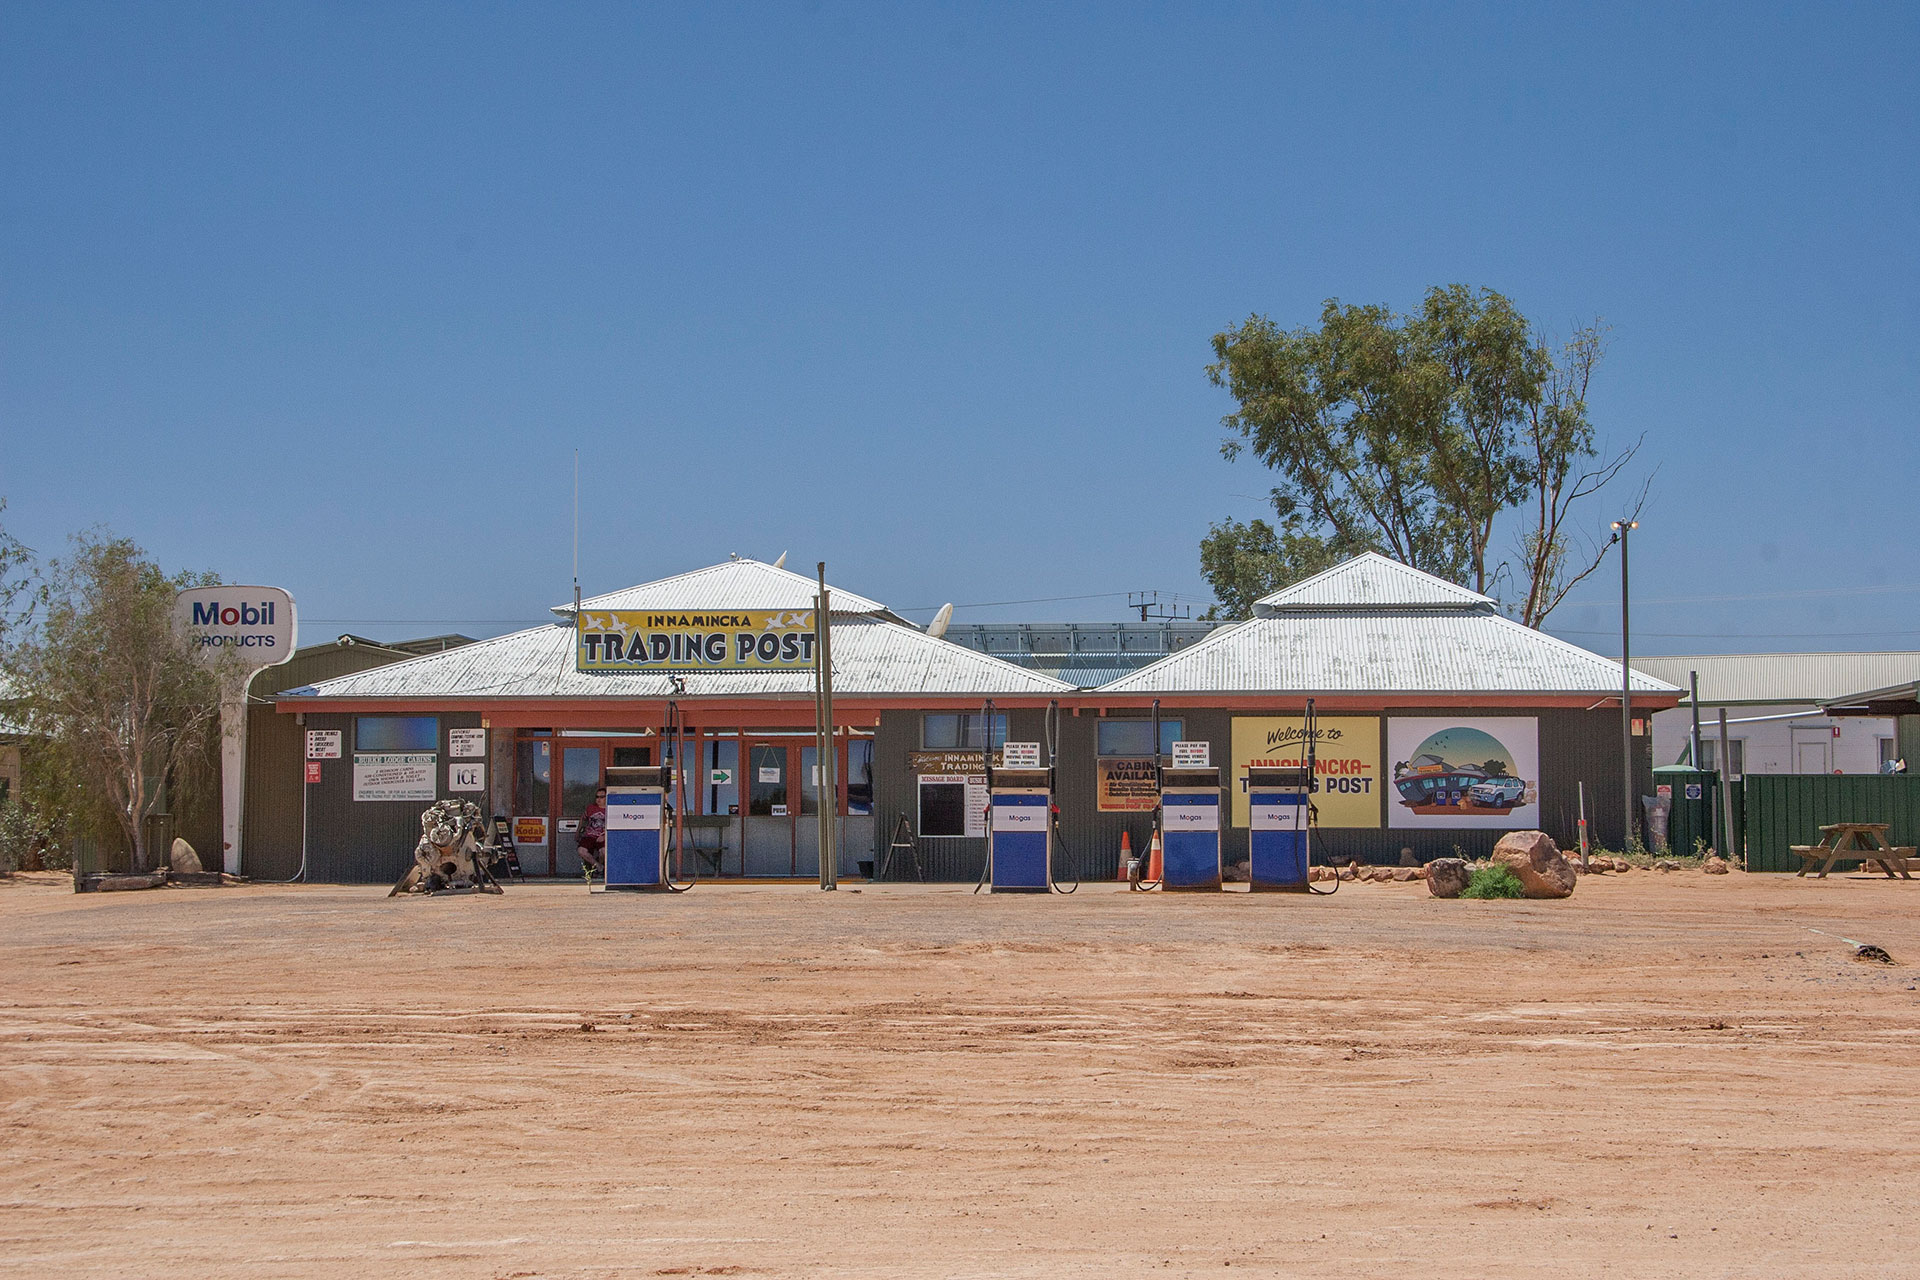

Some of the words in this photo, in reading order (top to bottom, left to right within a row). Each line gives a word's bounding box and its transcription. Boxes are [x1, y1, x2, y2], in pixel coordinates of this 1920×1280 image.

[193, 602, 275, 625] Mobil
[647, 615, 751, 627] INNAMINCKA
[583, 629, 727, 664] TRADING
[737, 632, 815, 663] POST
[1267, 727, 1325, 745] Welcome
[1327, 728, 1344, 740] to
[384, 756, 404, 764] LODGE
[944, 754, 1004, 762] INNAMINK
[941, 762, 985, 770] TRADING
[1117, 761, 1155, 771] CABIN
[456, 768, 478, 785] ICE
[1326, 777, 1373, 794] POST
[516, 826, 545, 835] Kodak
